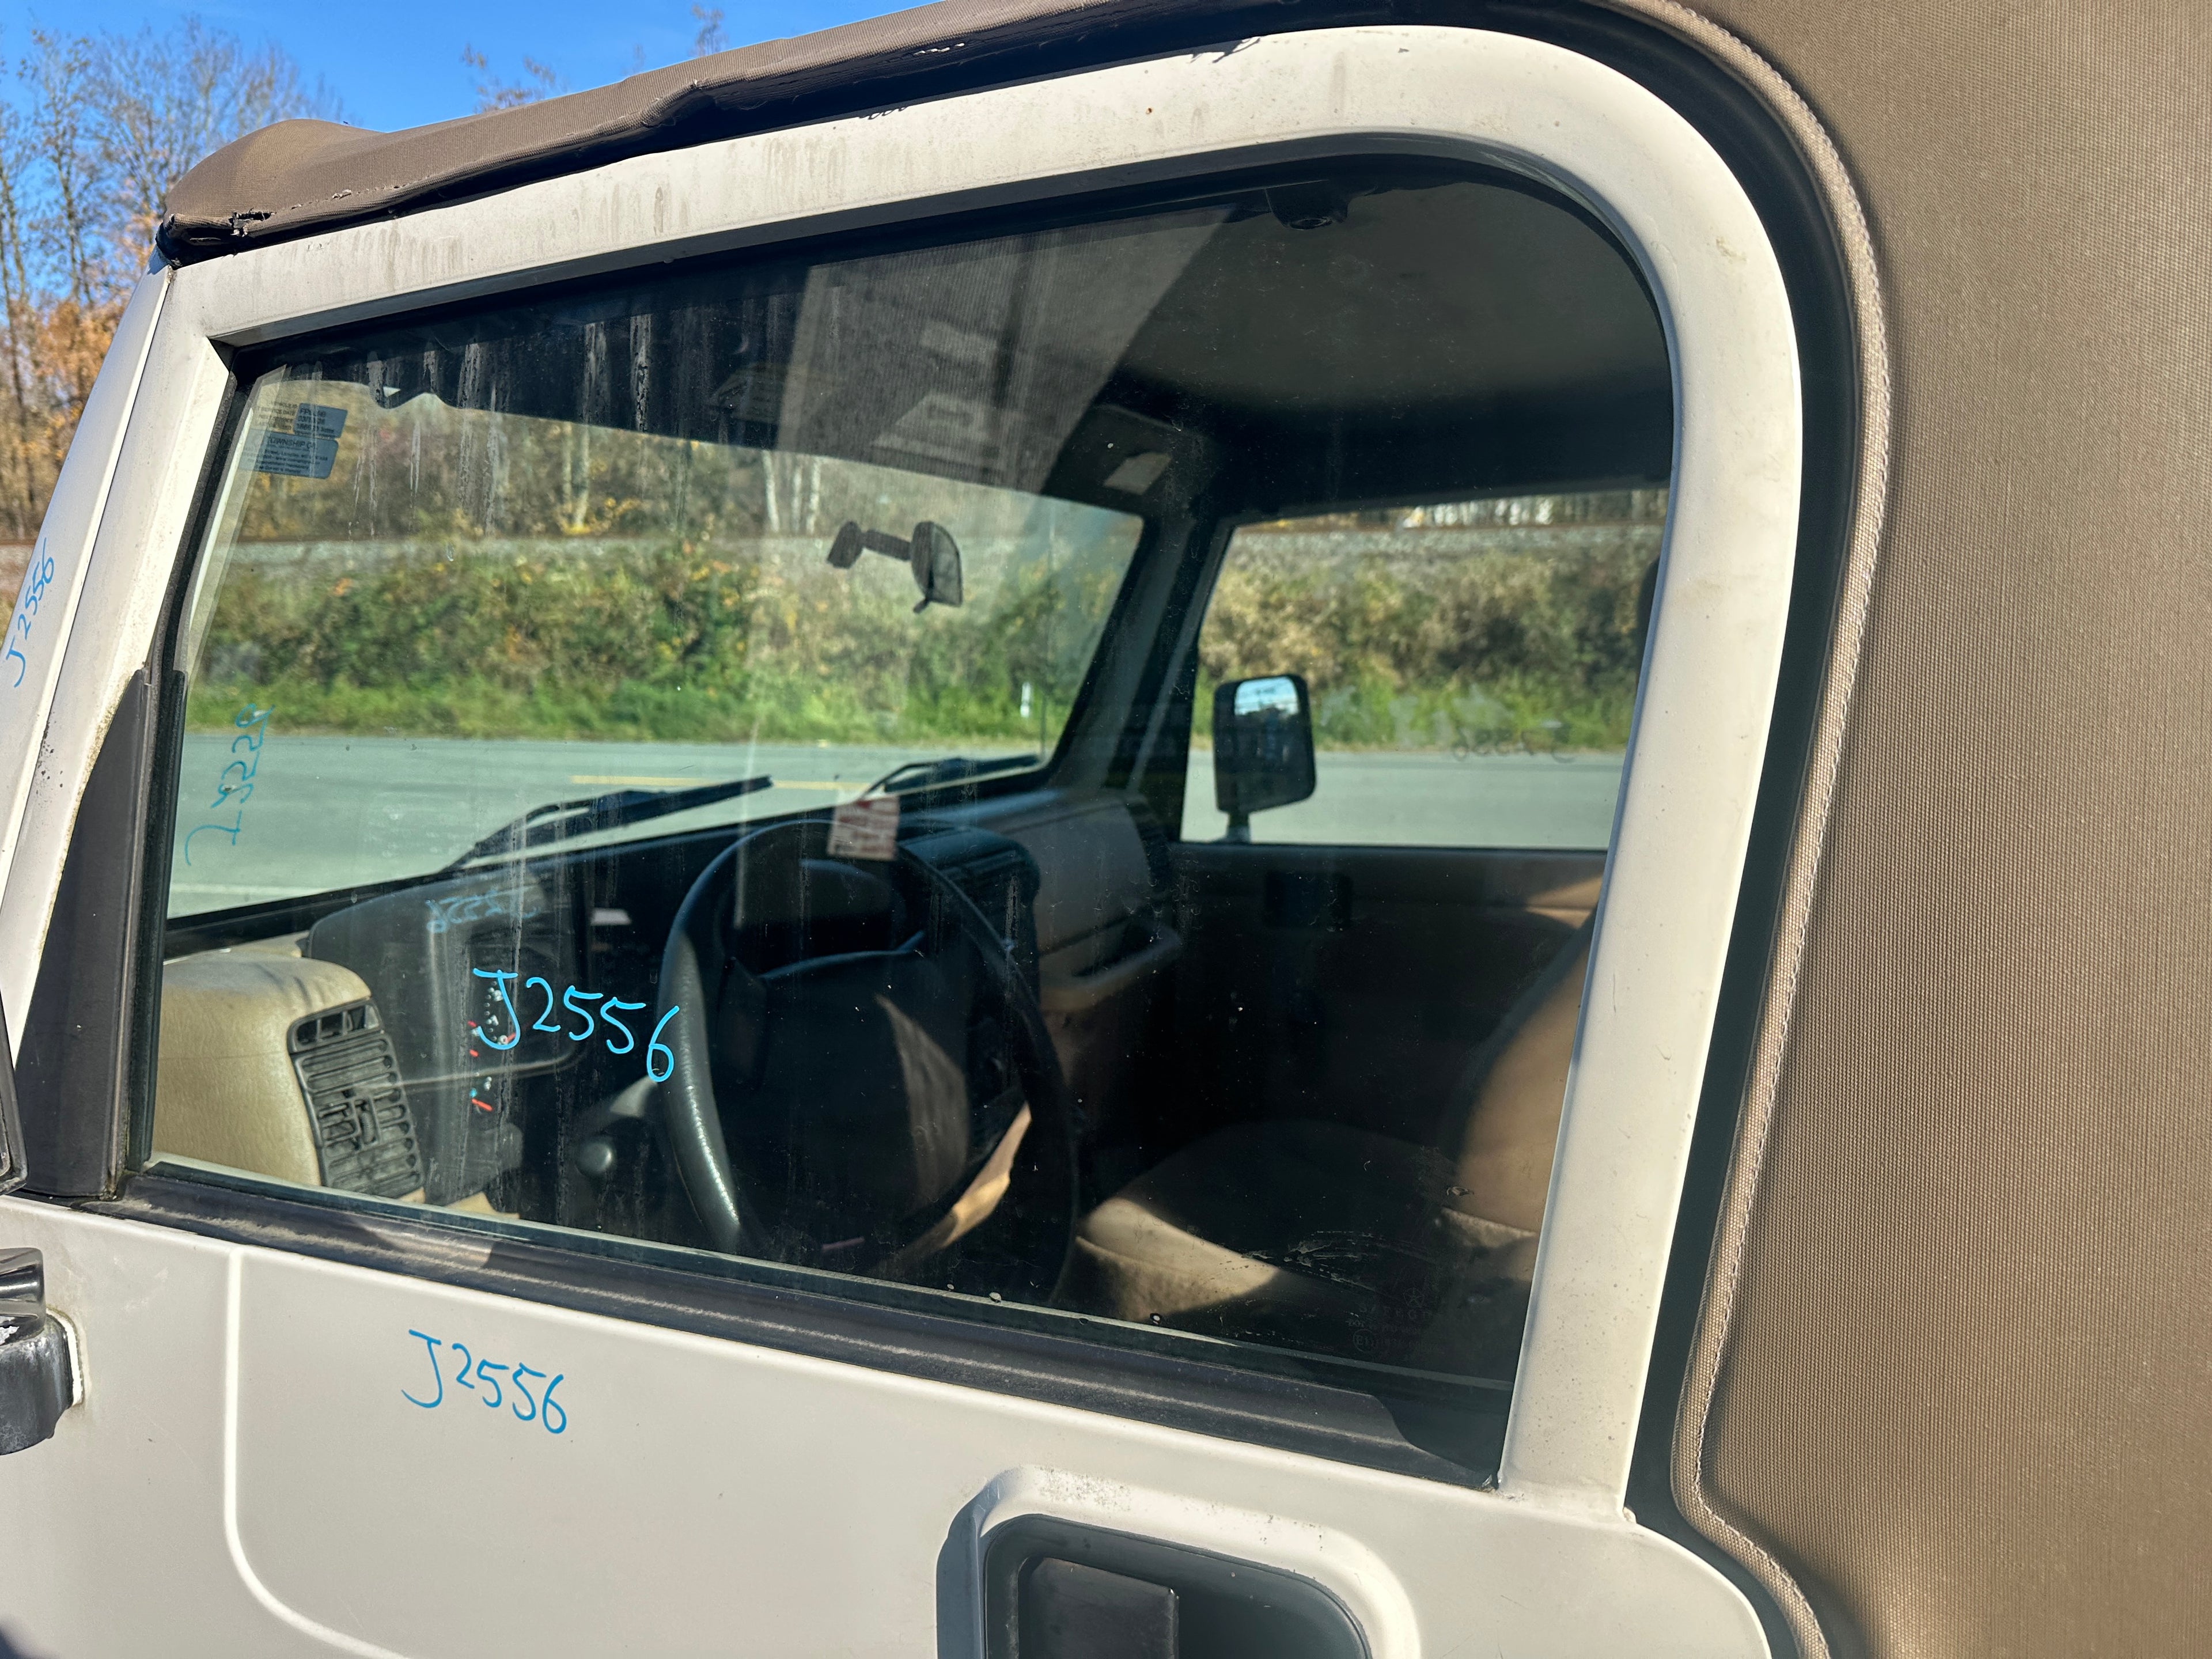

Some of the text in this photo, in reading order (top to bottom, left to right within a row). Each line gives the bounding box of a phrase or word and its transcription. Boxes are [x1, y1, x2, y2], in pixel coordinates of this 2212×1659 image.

[6, 536, 55, 688] J2556
[472, 968, 680, 1082] J2556
[401, 1328, 567, 1434] J2556
